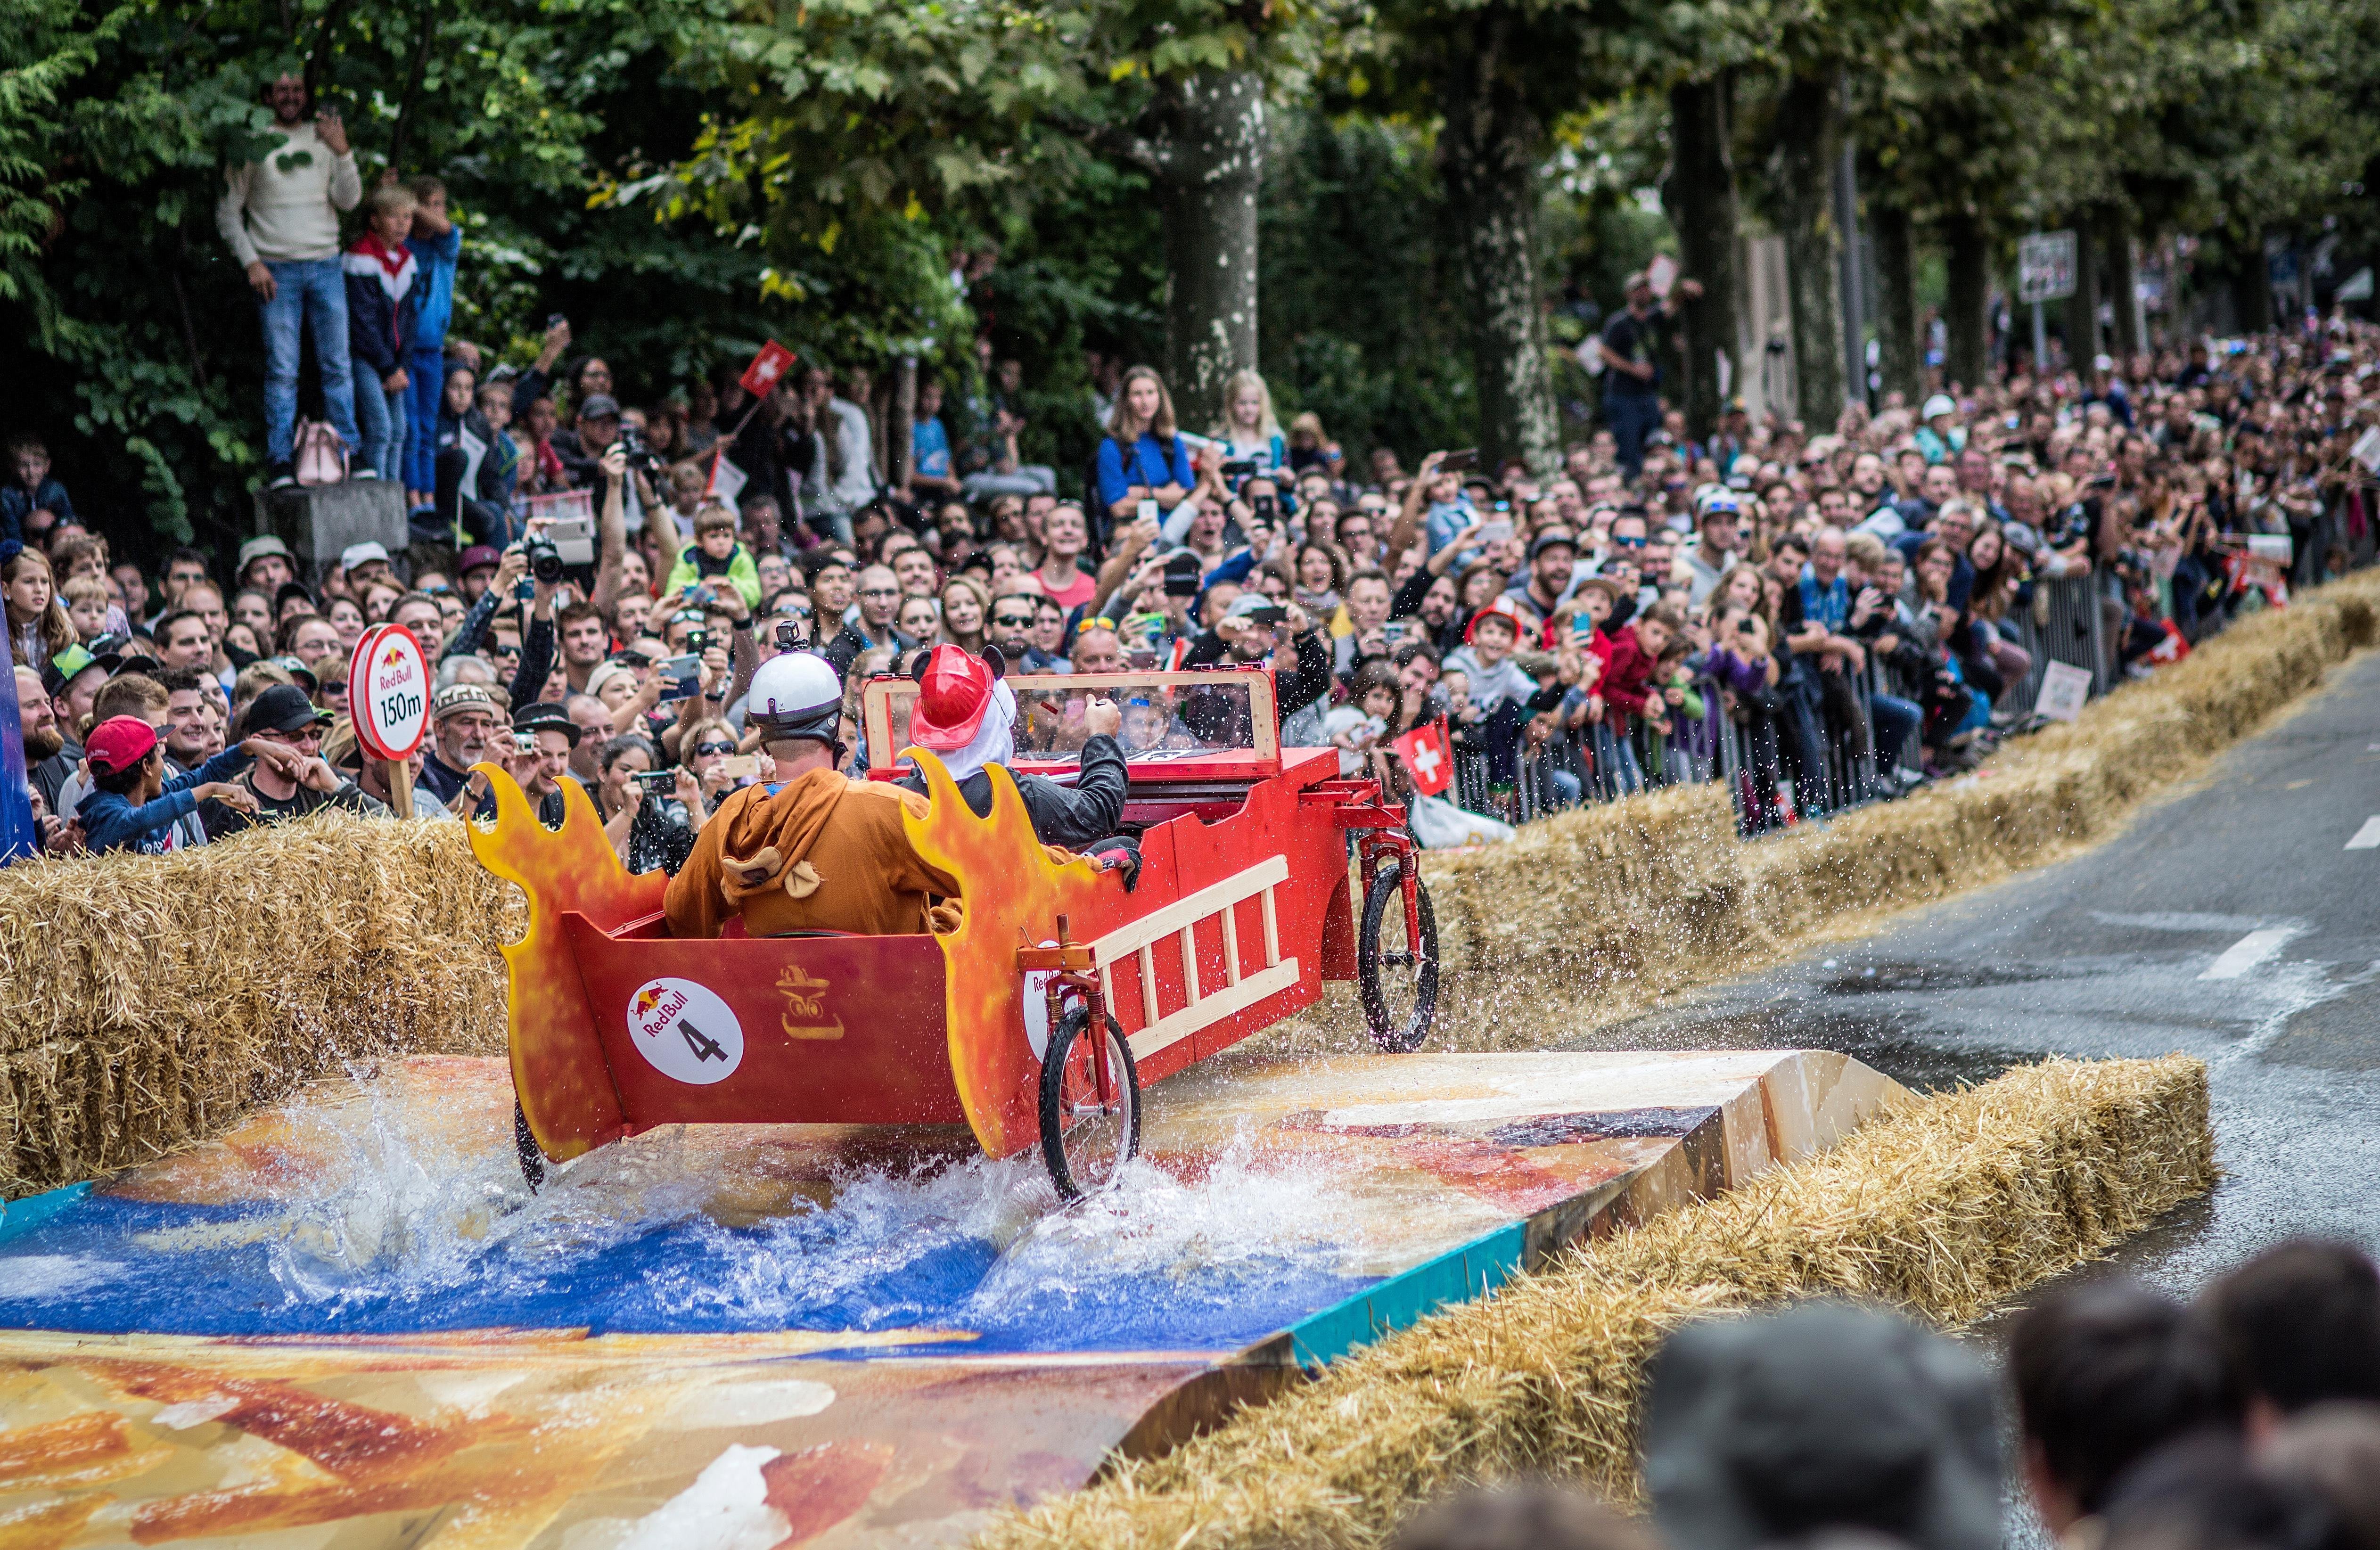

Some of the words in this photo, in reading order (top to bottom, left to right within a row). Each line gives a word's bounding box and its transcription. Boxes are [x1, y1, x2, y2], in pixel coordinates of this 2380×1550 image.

[380, 671, 396, 690] Red
[396, 665, 411, 684] Bull
[380, 692, 421, 728] 150m
[643, 1010, 670, 1038] Red
[661, 990, 689, 1017] Bull
[677, 1018, 729, 1063] 4
